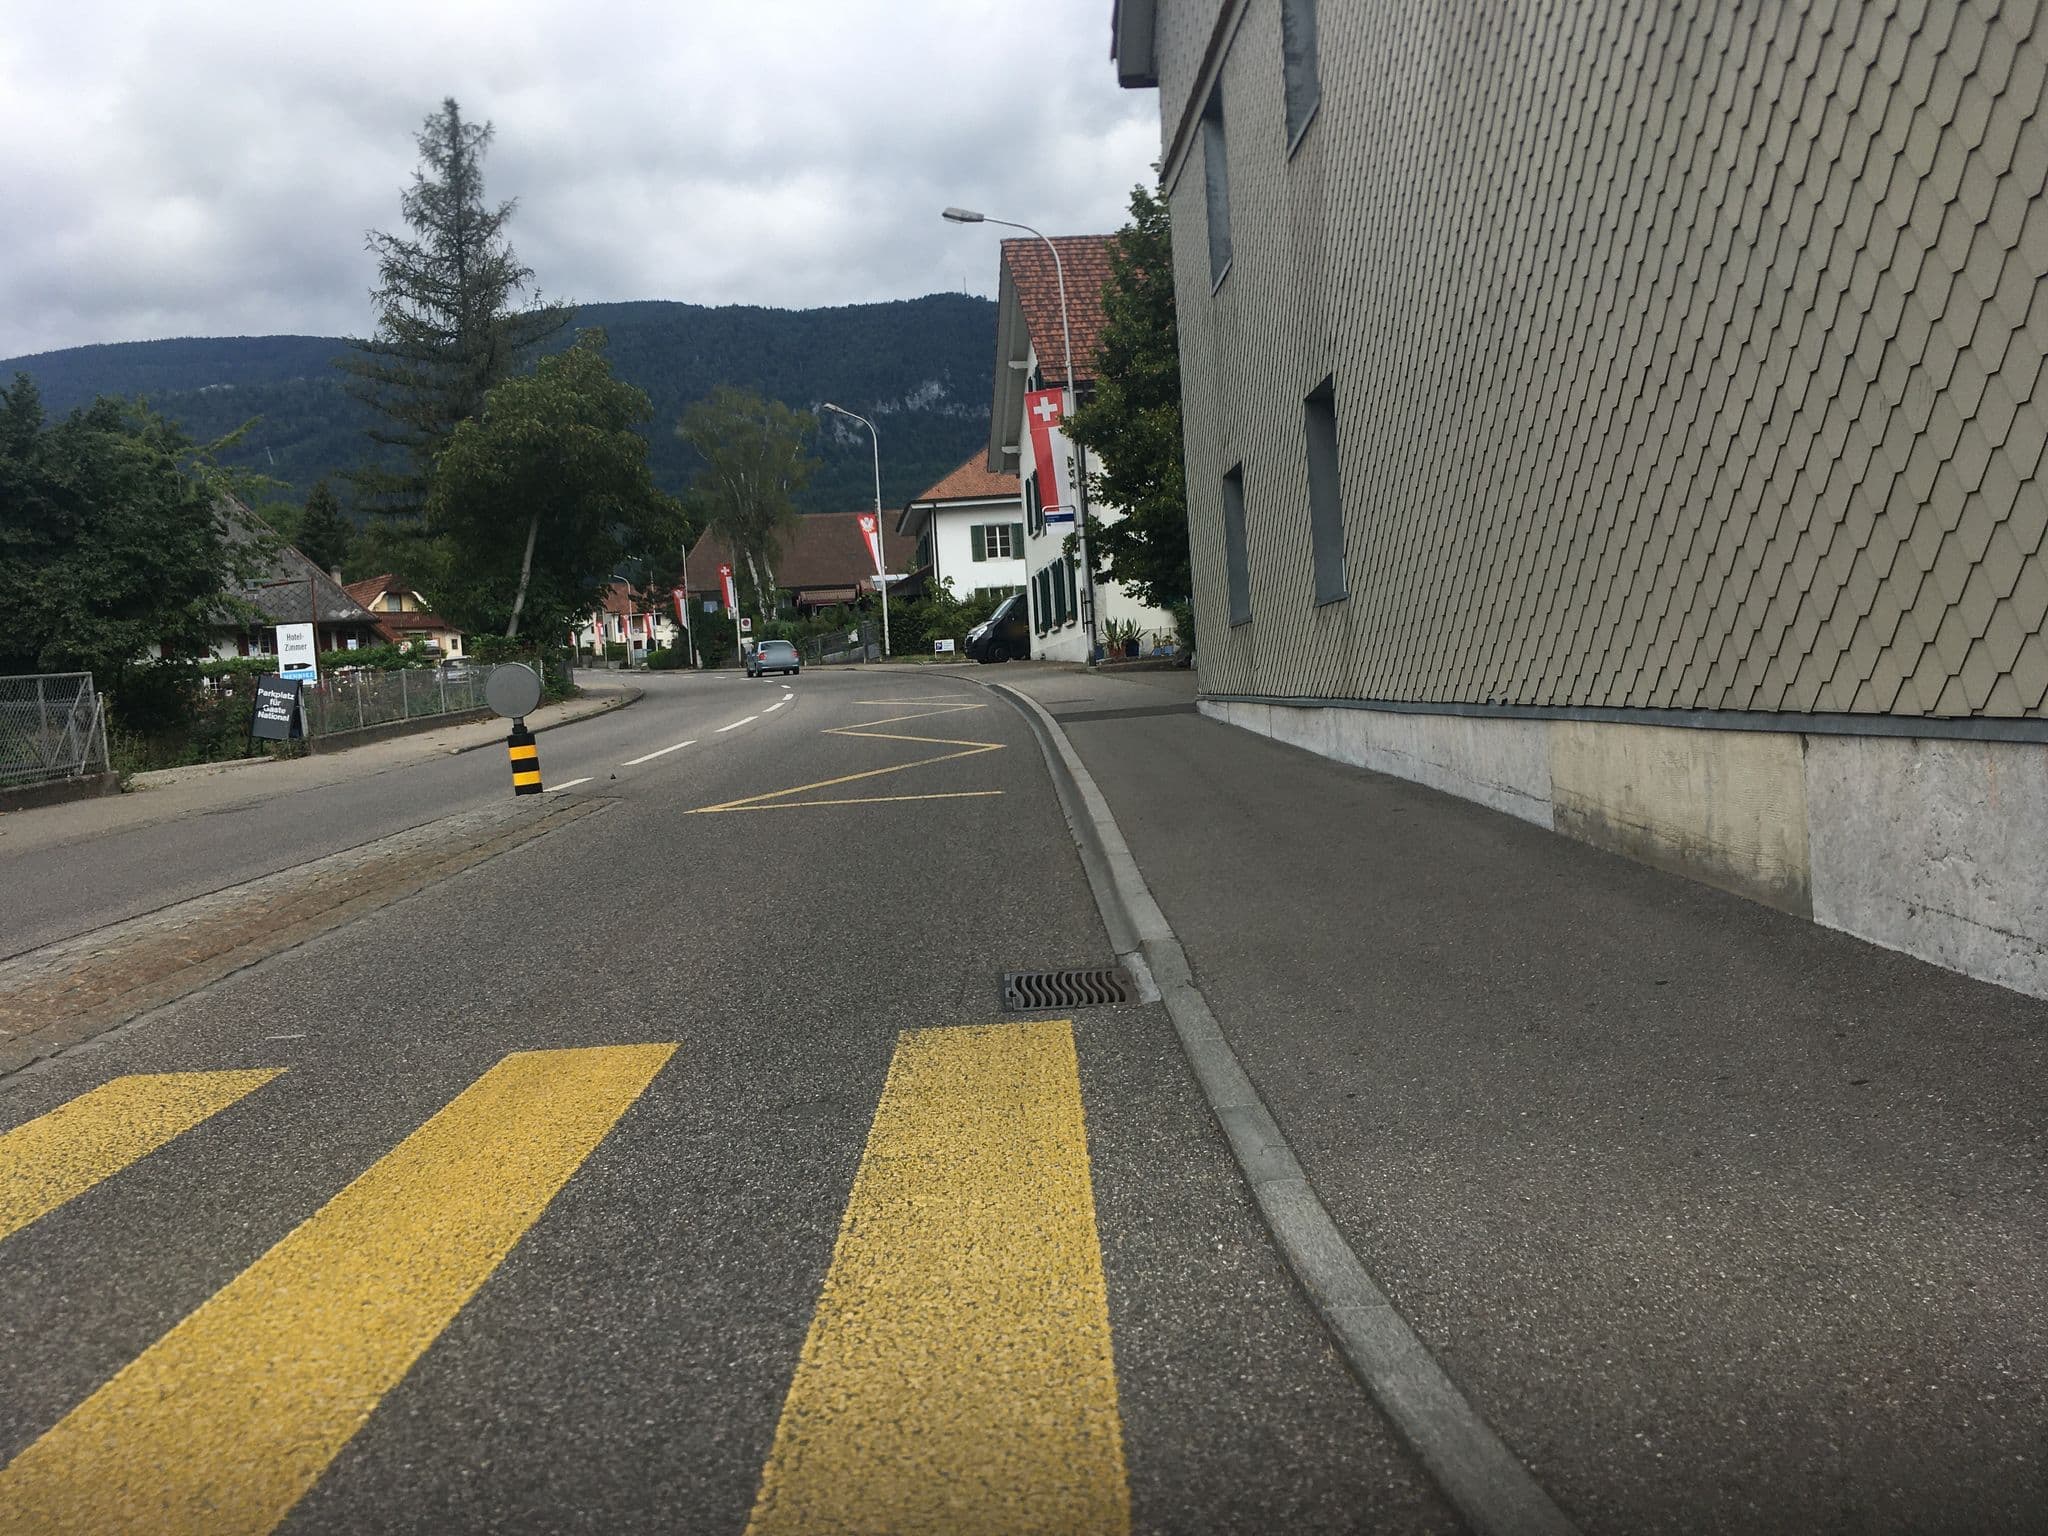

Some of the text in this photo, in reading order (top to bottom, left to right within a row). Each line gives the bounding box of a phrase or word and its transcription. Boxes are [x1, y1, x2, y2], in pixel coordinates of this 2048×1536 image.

[284, 643, 307, 652] Zimmer
[258, 688, 295, 700] Parkplatz
[270, 698, 282, 706] für
[258, 711, 289, 722] National
